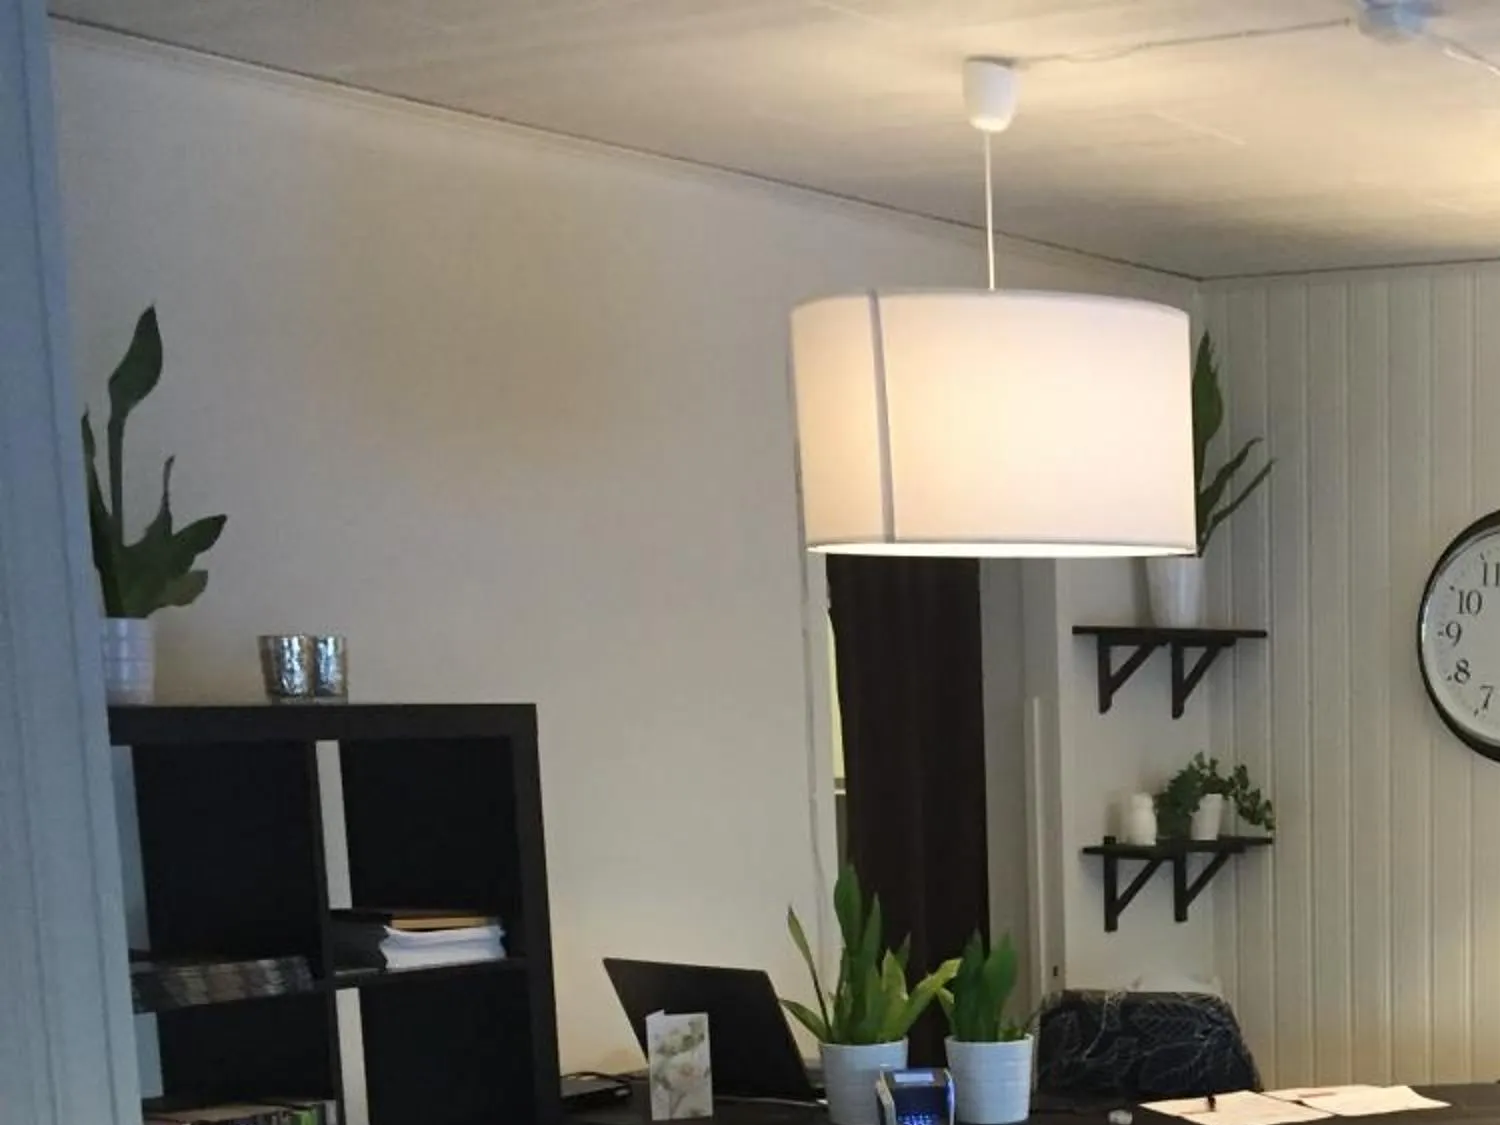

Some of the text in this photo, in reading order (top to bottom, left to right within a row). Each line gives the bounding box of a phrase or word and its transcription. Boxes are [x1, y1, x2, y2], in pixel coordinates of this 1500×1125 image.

[1482, 561, 1500, 588] 11
[1456, 589, 1484, 616] 10
[1445, 621, 1462, 647] 9
[1453, 658, 1471, 684] 8
[1479, 685, 1495, 711] 7
